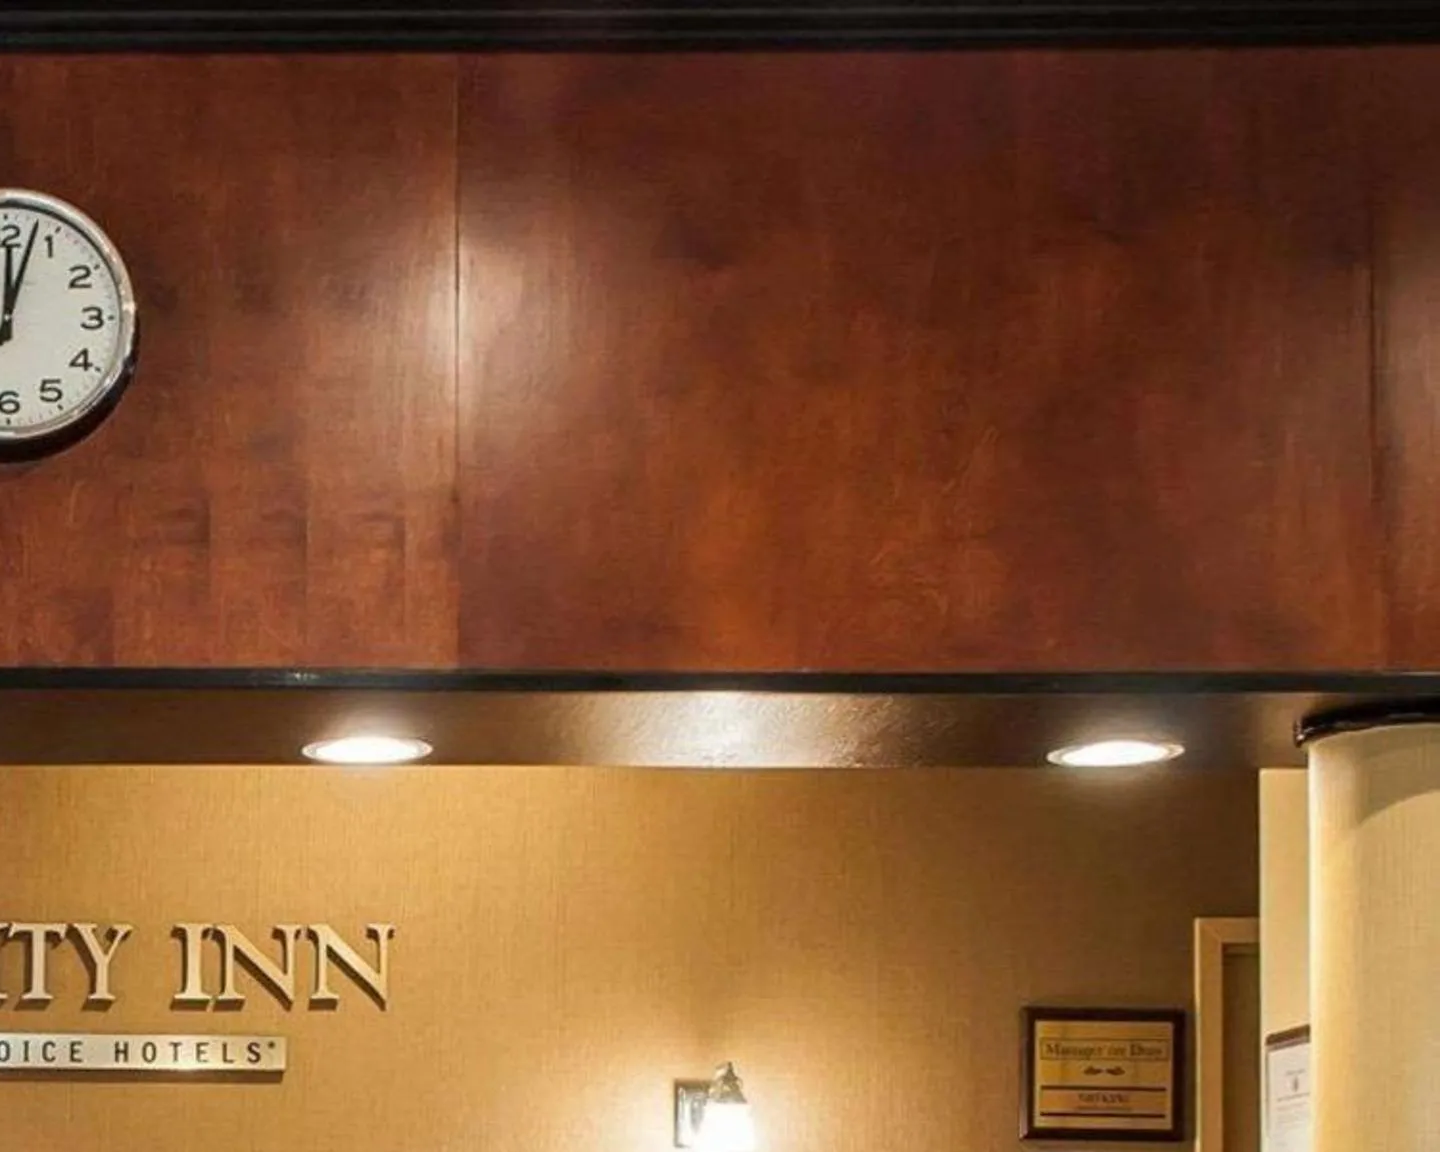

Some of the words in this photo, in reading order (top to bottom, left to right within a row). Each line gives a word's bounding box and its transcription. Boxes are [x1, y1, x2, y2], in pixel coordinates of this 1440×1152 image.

[45, 235, 53, 258] 1
[69, 265, 91, 288] 2
[81, 307, 103, 329] 3
[69, 349, 92, 371] 4
[40, 379, 62, 402] 5
[173, 923, 396, 1003] INN
